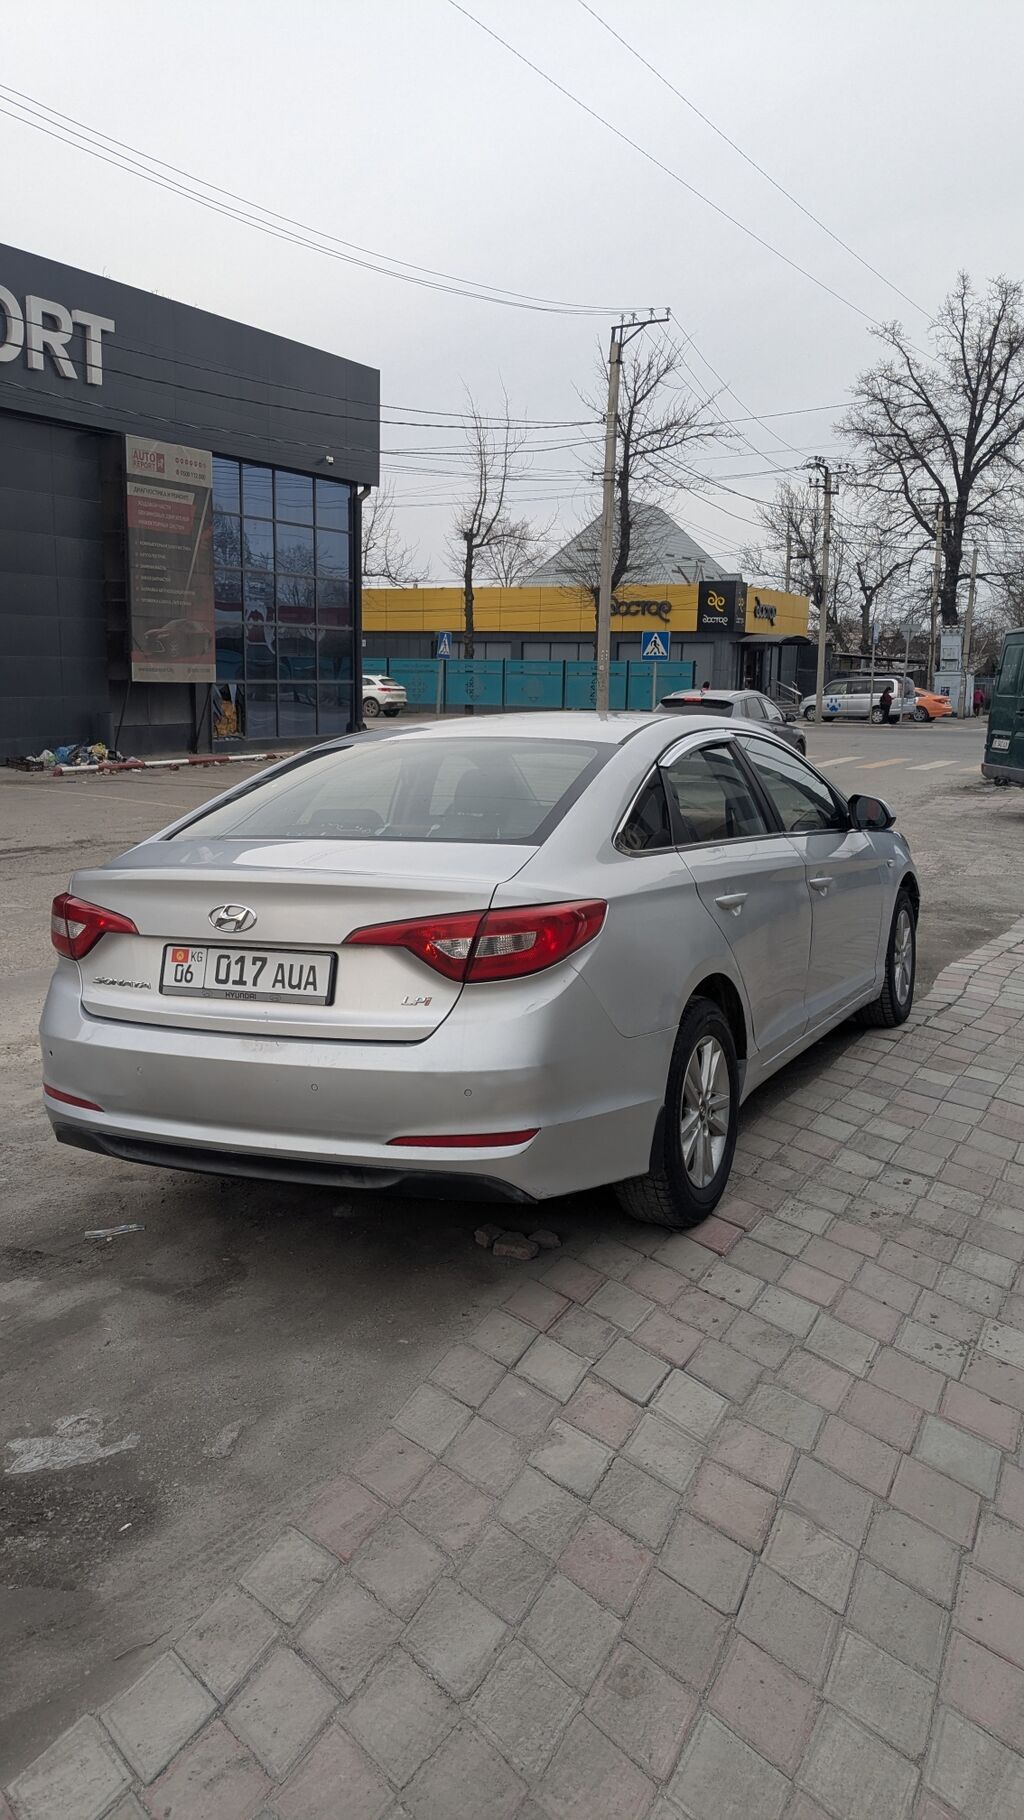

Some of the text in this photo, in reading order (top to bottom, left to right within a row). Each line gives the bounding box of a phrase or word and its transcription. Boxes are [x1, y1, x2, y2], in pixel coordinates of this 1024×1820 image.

[133, 450, 155, 463] AUTO
[190, 951, 203, 963] KG
[173, 963, 194, 983] 06
[214, 954, 318, 992] 017 AUA
[92, 976, 151, 990] SONATA
[225, 991, 257, 1000] HYUNDAI
